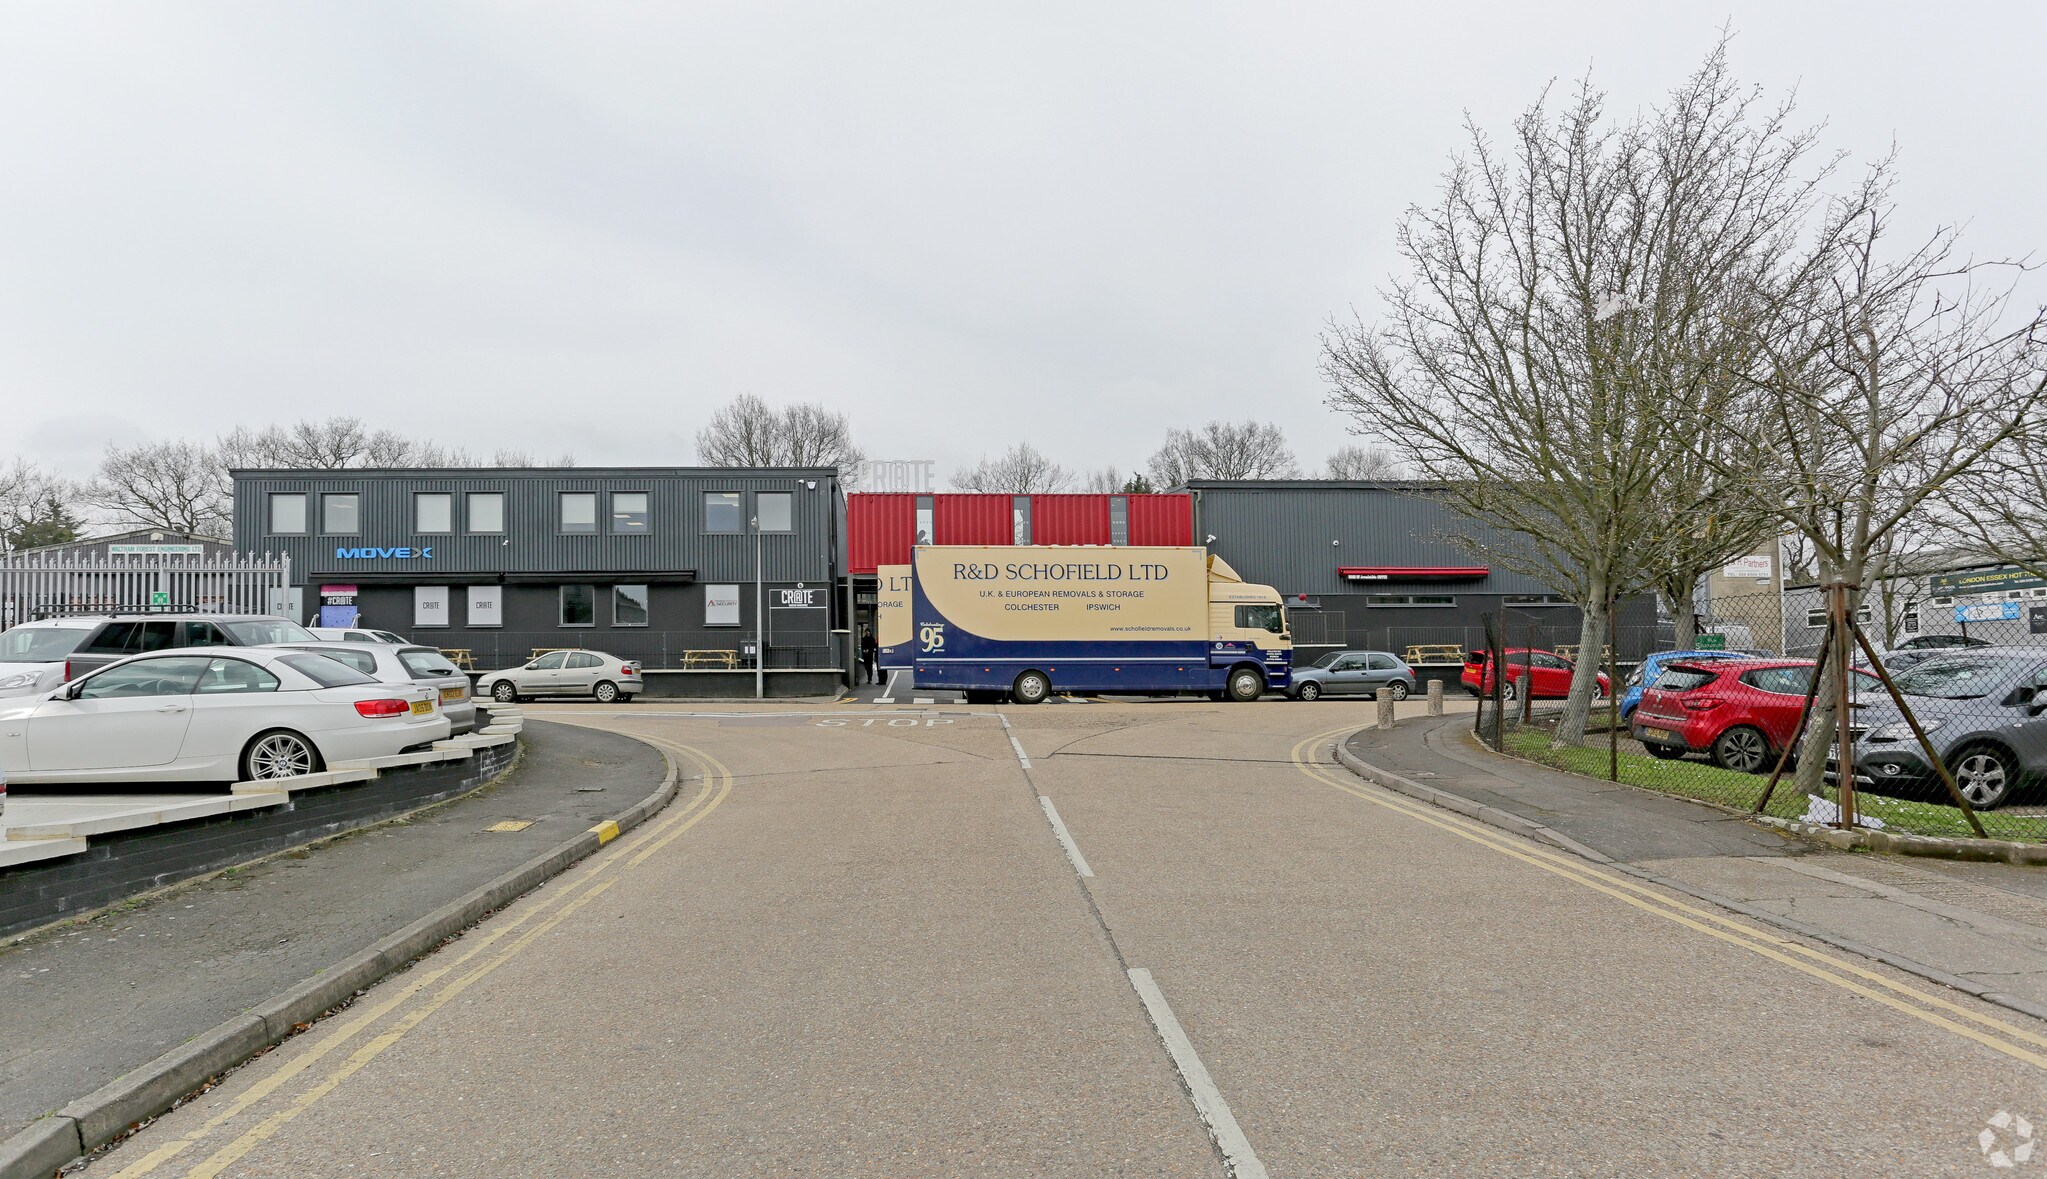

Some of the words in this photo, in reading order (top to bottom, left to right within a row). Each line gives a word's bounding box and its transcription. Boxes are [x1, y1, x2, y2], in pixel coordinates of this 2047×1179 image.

[336, 547, 433, 559] MOVEX
[1743, 557, 1769, 568] Partners
[953, 563, 999, 580] R&D
[1005, 563, 1122, 580] SCHOFIELD
[1128, 564, 1168, 581] LTD
[1959, 576, 1985, 584] LONDON
[1986, 573, 2008, 582] ESSEX
[979, 590, 996, 598] U.K.
[1005, 590, 1050, 598] EUROPEAN
[1052, 590, 1097, 598] REMOVALS
[1106, 590, 1145, 598] STORAGE
[1004, 603, 1060, 611] COLCHESTER
[1086, 603, 1121, 611] IPSWICH
[920, 627, 945, 653] 95
[816, 718, 954, 727] STOP
